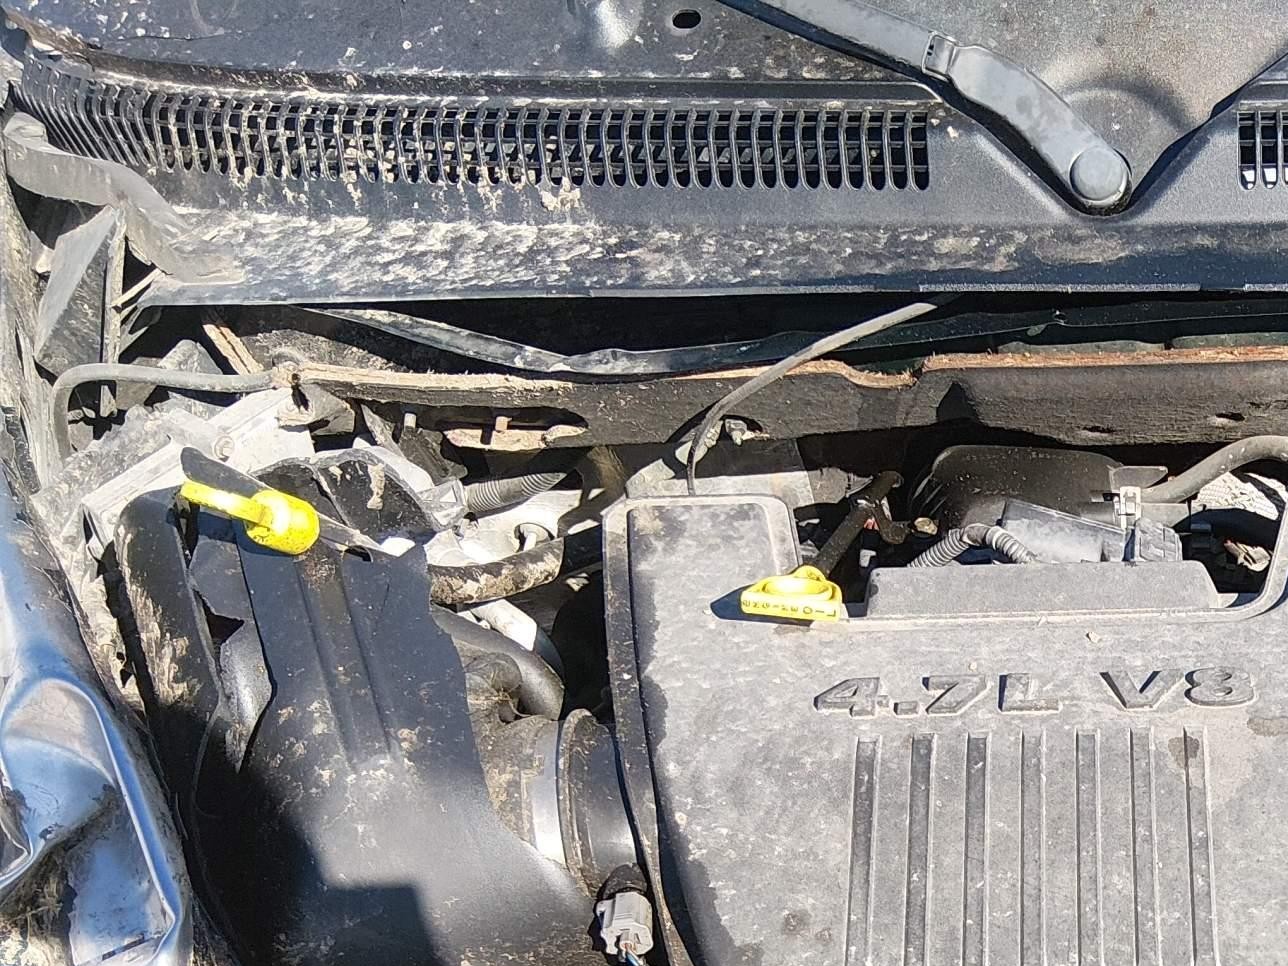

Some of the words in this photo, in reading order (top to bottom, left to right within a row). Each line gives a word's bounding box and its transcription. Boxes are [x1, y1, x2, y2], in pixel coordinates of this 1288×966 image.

[803, 606, 837, 617] OIL
[812, 672, 1063, 717] 4.7L
[1100, 666, 1258, 711] V8
